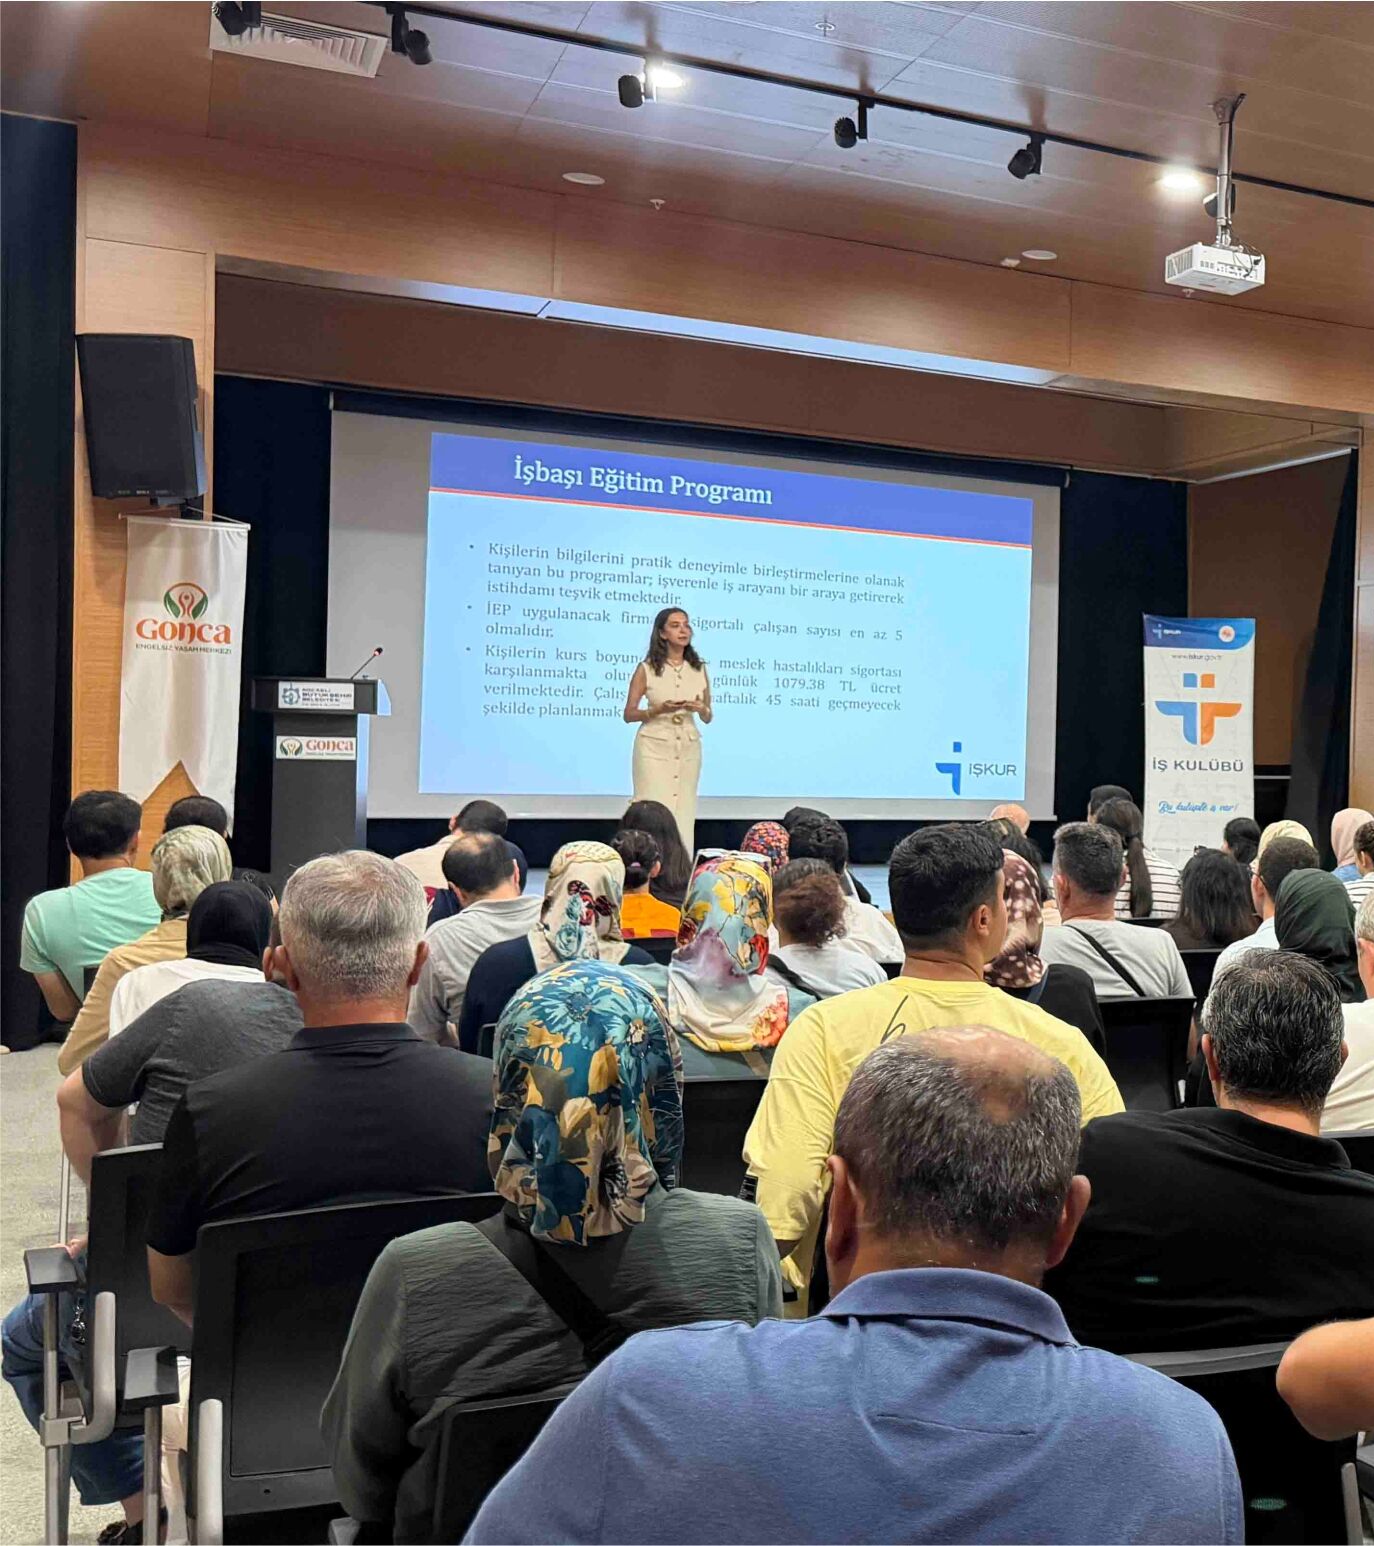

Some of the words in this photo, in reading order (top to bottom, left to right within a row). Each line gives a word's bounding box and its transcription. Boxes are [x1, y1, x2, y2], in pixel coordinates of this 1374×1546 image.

[514, 455, 583, 489] İşbaşı
[590, 467, 664, 494] Eğitim
[670, 475, 772, 505] Programı
[489, 543, 549, 559] Kişilerin
[557, 547, 624, 565] bilgilerini
[631, 556, 672, 570] pratik
[679, 558, 747, 575] deneyimle
[754, 564, 859, 584] birleştirmelerine
[865, 574, 905, 588] olanak
[487, 581, 555, 597] istihdamı
[559, 587, 600, 601] teşvik
[605, 591, 682, 605] etmektedir.
[488, 563, 541, 578] tanıyan
[547, 565, 564, 579] bu
[570, 570, 653, 586] programlar;
[658, 574, 718, 590] işverenle
[723, 579, 733, 593] iş
[738, 583, 785, 596] arayanı
[790, 585, 808, 597] bir
[812, 589, 846, 602] araya
[850, 591, 904, 604] getirerek
[136, 618, 231, 645] Gonca
[486, 622, 554, 638] olmalıdır.
[487, 600, 511, 616] İEP
[522, 607, 611, 623] uygulanacak
[621, 610, 654, 625] firm
[691, 617, 744, 632] sigortalı
[754, 621, 797, 636] çalışan
[807, 625, 841, 639] sayısı
[850, 629, 865, 639] en
[873, 631, 887, 641] az
[896, 630, 903, 641] 5
[485, 644, 546, 660] Kişilerin
[556, 647, 587, 661] kurs
[719, 658, 765, 670] meslek
[774, 660, 843, 674] hastalıkları
[850, 666, 901, 678] sigortası
[484, 663, 587, 680] karşılanmakta
[713, 675, 757, 688] günlük
[774, 677, 825, 691] 1079.38
[840, 680, 856, 692] TL
[871, 683, 901, 694] ücret
[483, 702, 535, 717] şekilde
[539, 703, 623, 718] planlanmak
[484, 683, 584, 699] verilmektedir.
[594, 686, 626, 701] Çalış
[766, 694, 781, 705] 45
[790, 696, 820, 708] saati
[828, 698, 901, 712] geçmeyecek
[306, 739, 354, 752] Gonca
[1152, 757, 1168, 772] İŞ
[1174, 758, 1244, 772] KULÜBÜ
